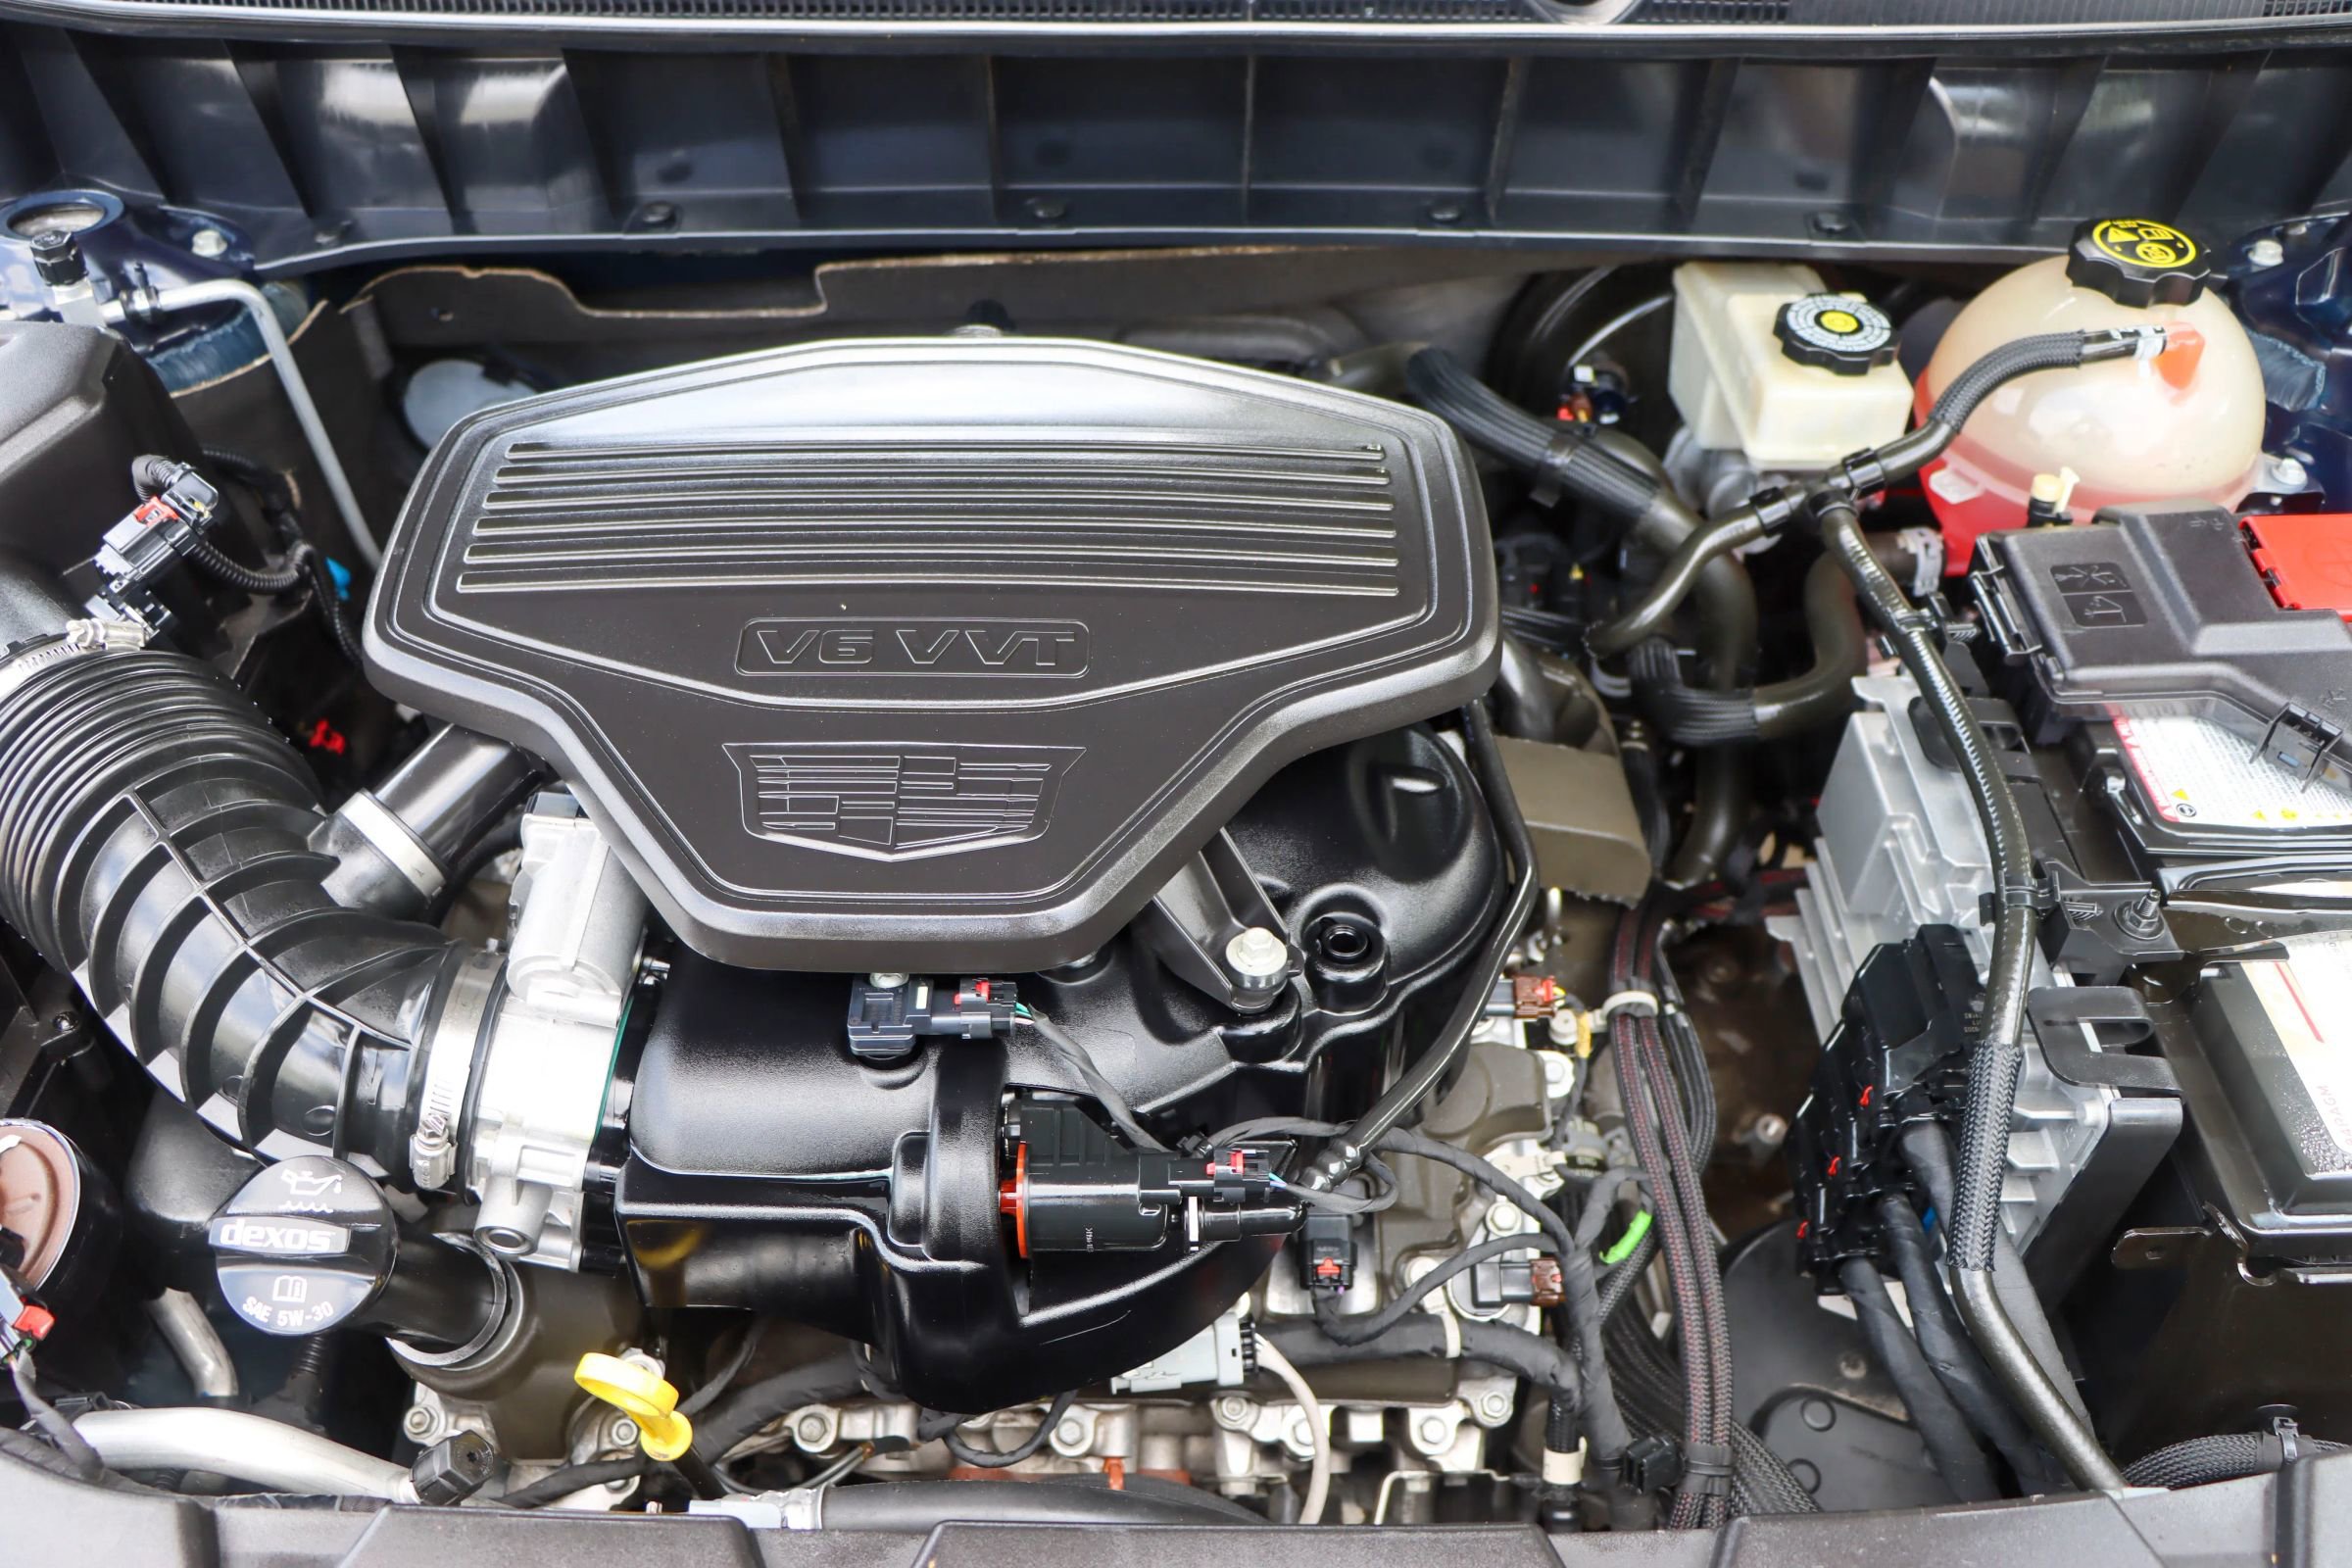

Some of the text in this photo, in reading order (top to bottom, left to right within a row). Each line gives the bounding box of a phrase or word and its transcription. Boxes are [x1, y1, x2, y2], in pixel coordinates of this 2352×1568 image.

[757, 628, 1075, 666] V6 VVT
[220, 1218, 331, 1251] dexos
[242, 1296, 334, 1327] SAE 5W-30
